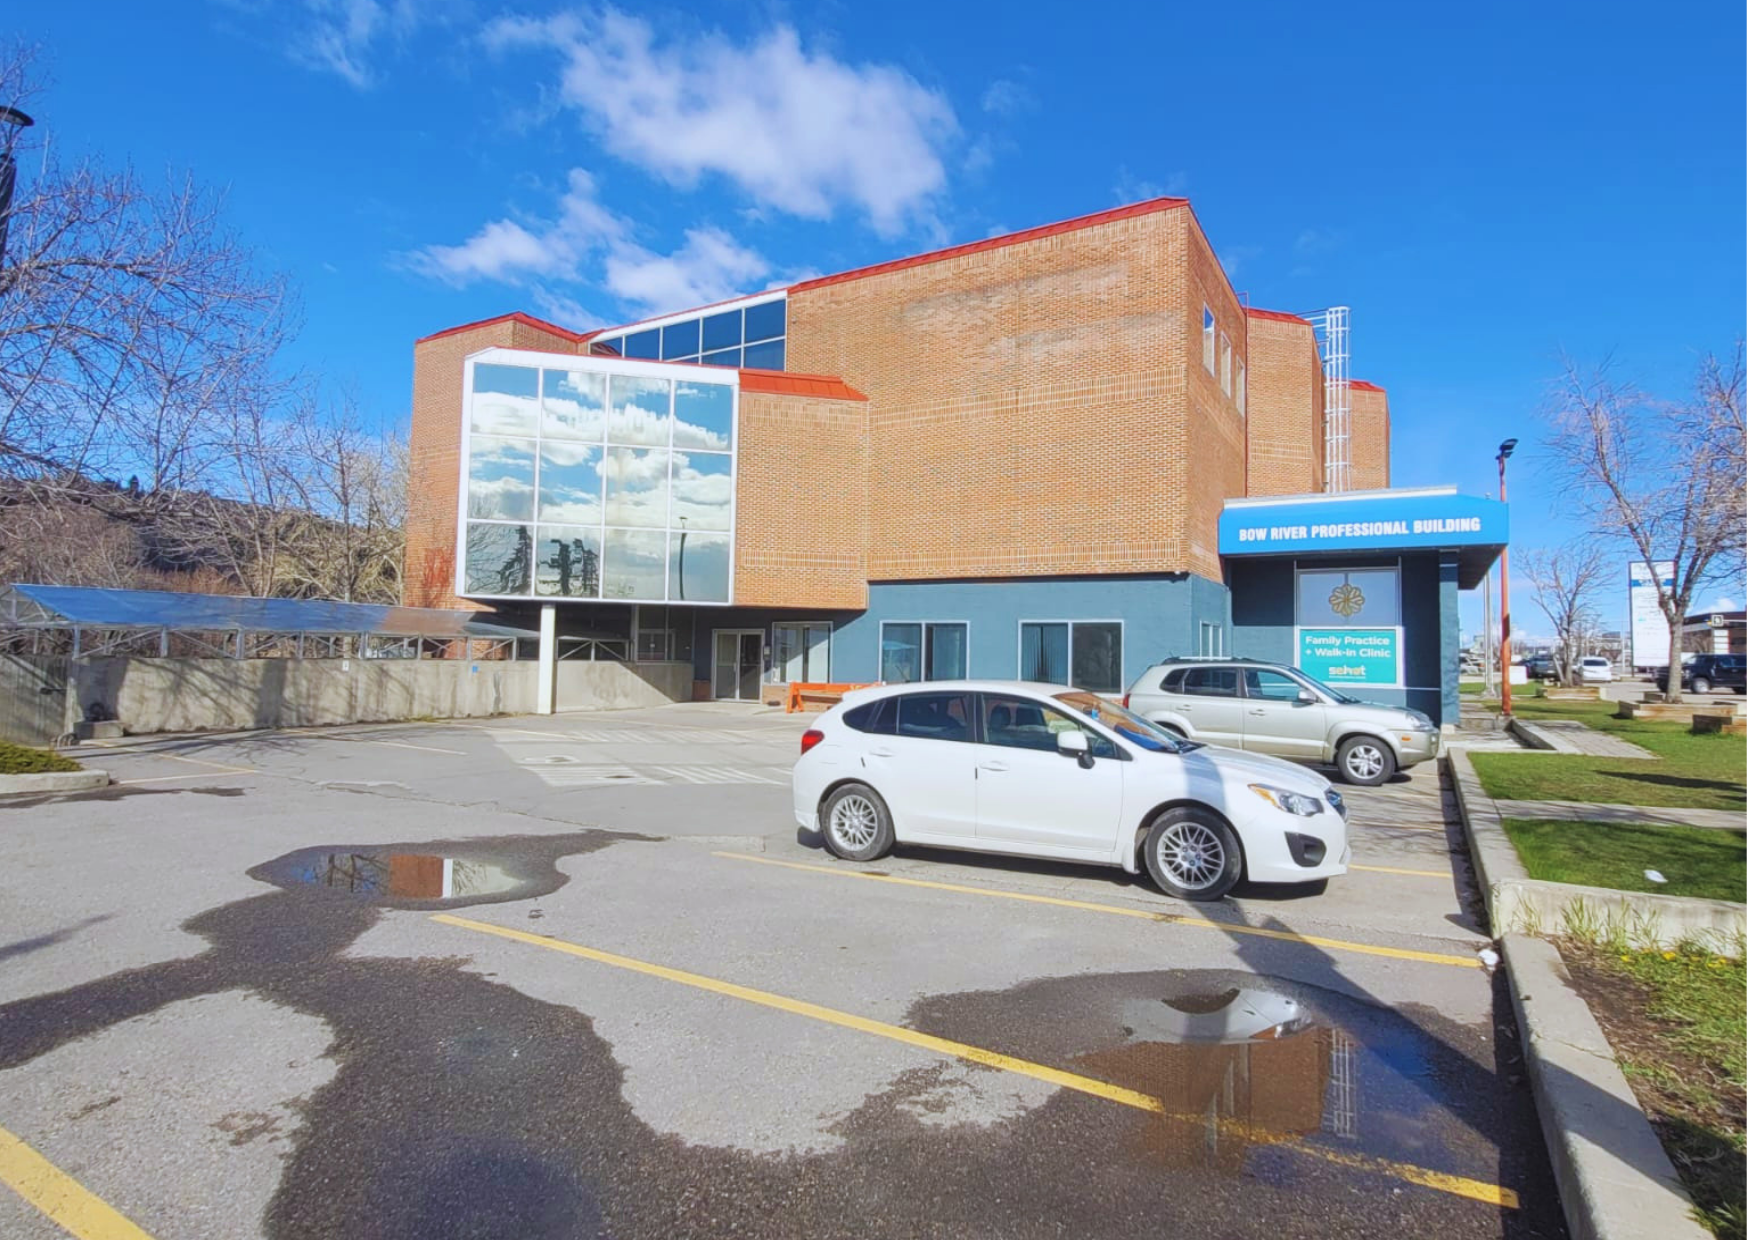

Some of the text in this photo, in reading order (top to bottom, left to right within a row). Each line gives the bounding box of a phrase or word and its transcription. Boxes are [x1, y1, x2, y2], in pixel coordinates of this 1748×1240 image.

[1239, 517, 1481, 542] BOW RIVER PROFESSIONAL BUILDING
[1305, 636, 1390, 646] Family Practice
[1359, 648, 1391, 658] Clinic
